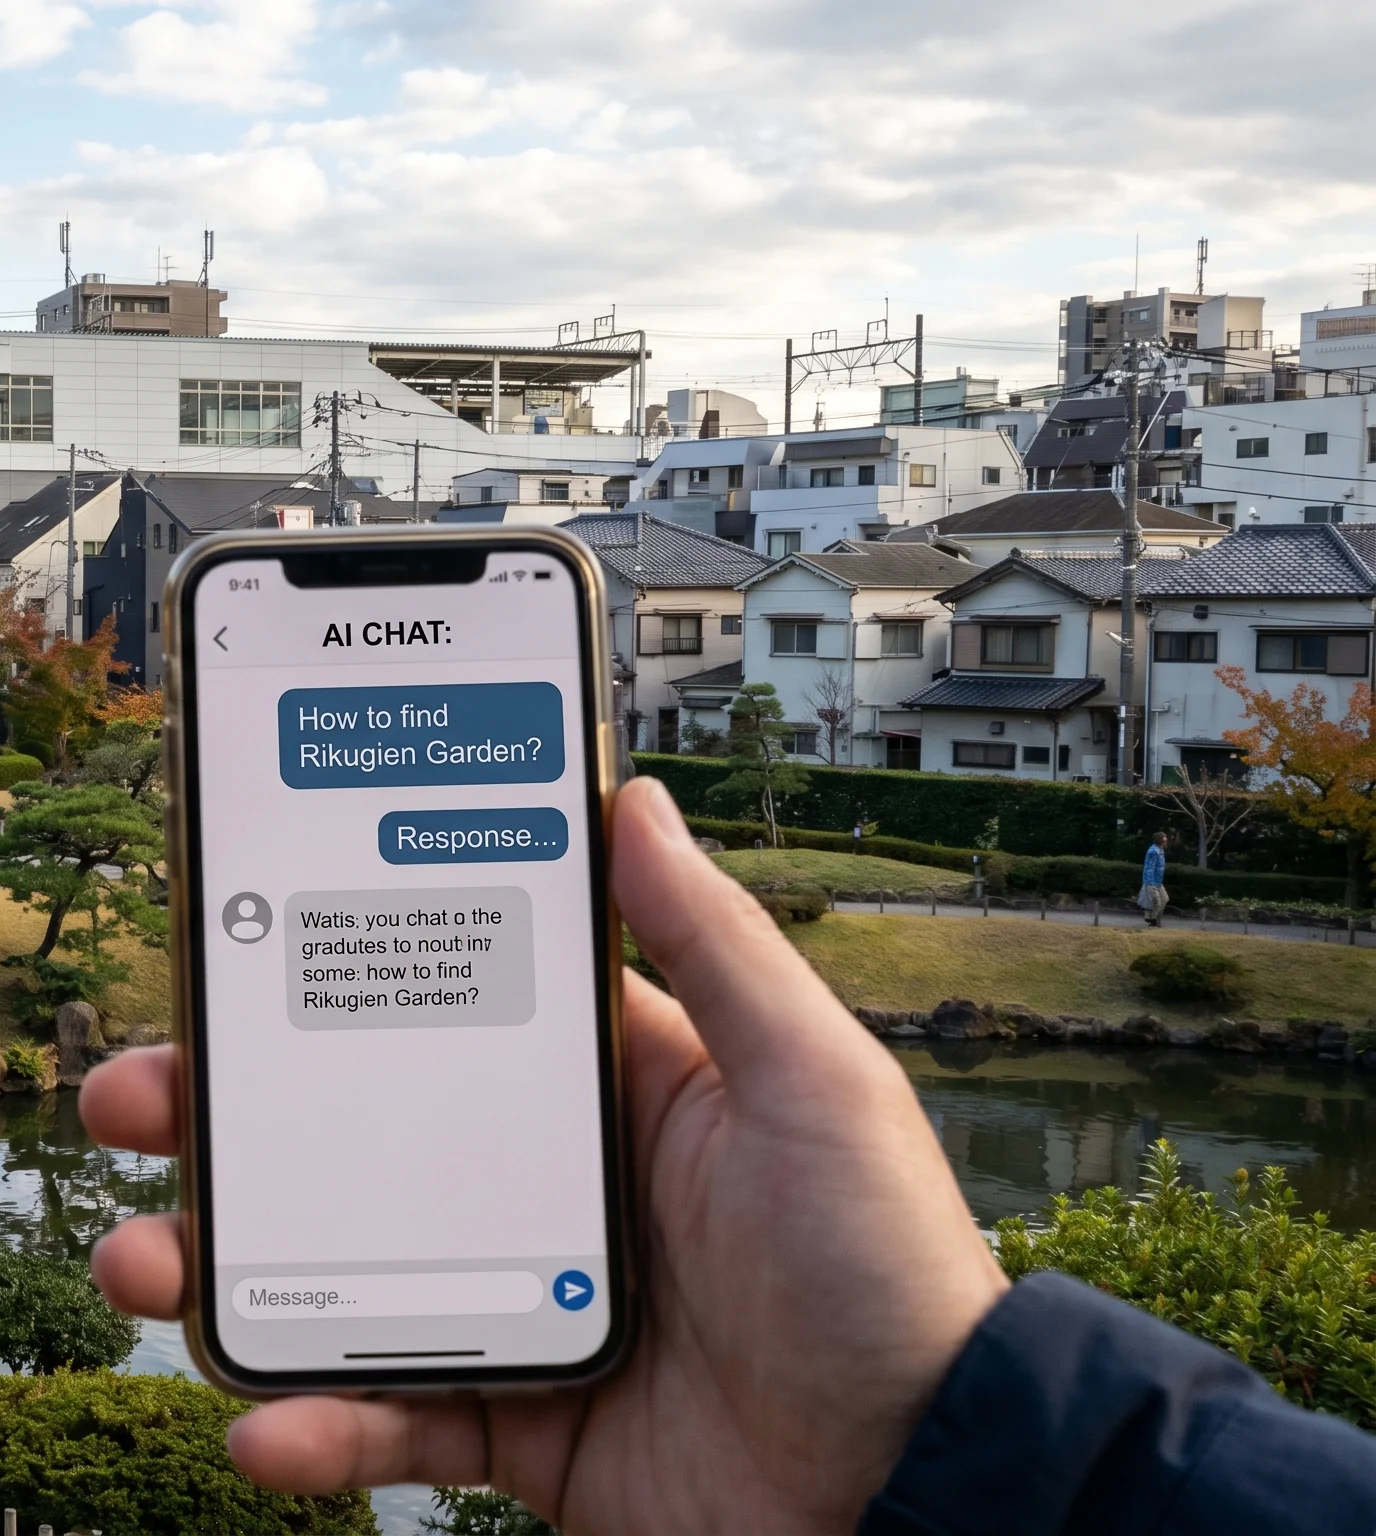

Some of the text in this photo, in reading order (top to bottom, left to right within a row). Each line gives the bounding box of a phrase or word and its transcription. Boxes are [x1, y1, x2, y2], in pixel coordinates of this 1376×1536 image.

[229, 578, 260, 592] 9:41
[322, 620, 452, 648] AI CHAT:
[299, 703, 448, 731] How to find
[300, 737, 542, 773] Rikugien Garden?
[397, 826, 557, 854] Response...
[365, 913, 400, 932] you
[406, 909, 449, 927] chat
[471, 908, 502, 925] the
[301, 937, 387, 961] gradutes
[392, 937, 412, 954] to
[302, 961, 472, 983] some: how to find
[304, 987, 479, 1013] Rikugien Garden?
[249, 1288, 357, 1310] Message...
